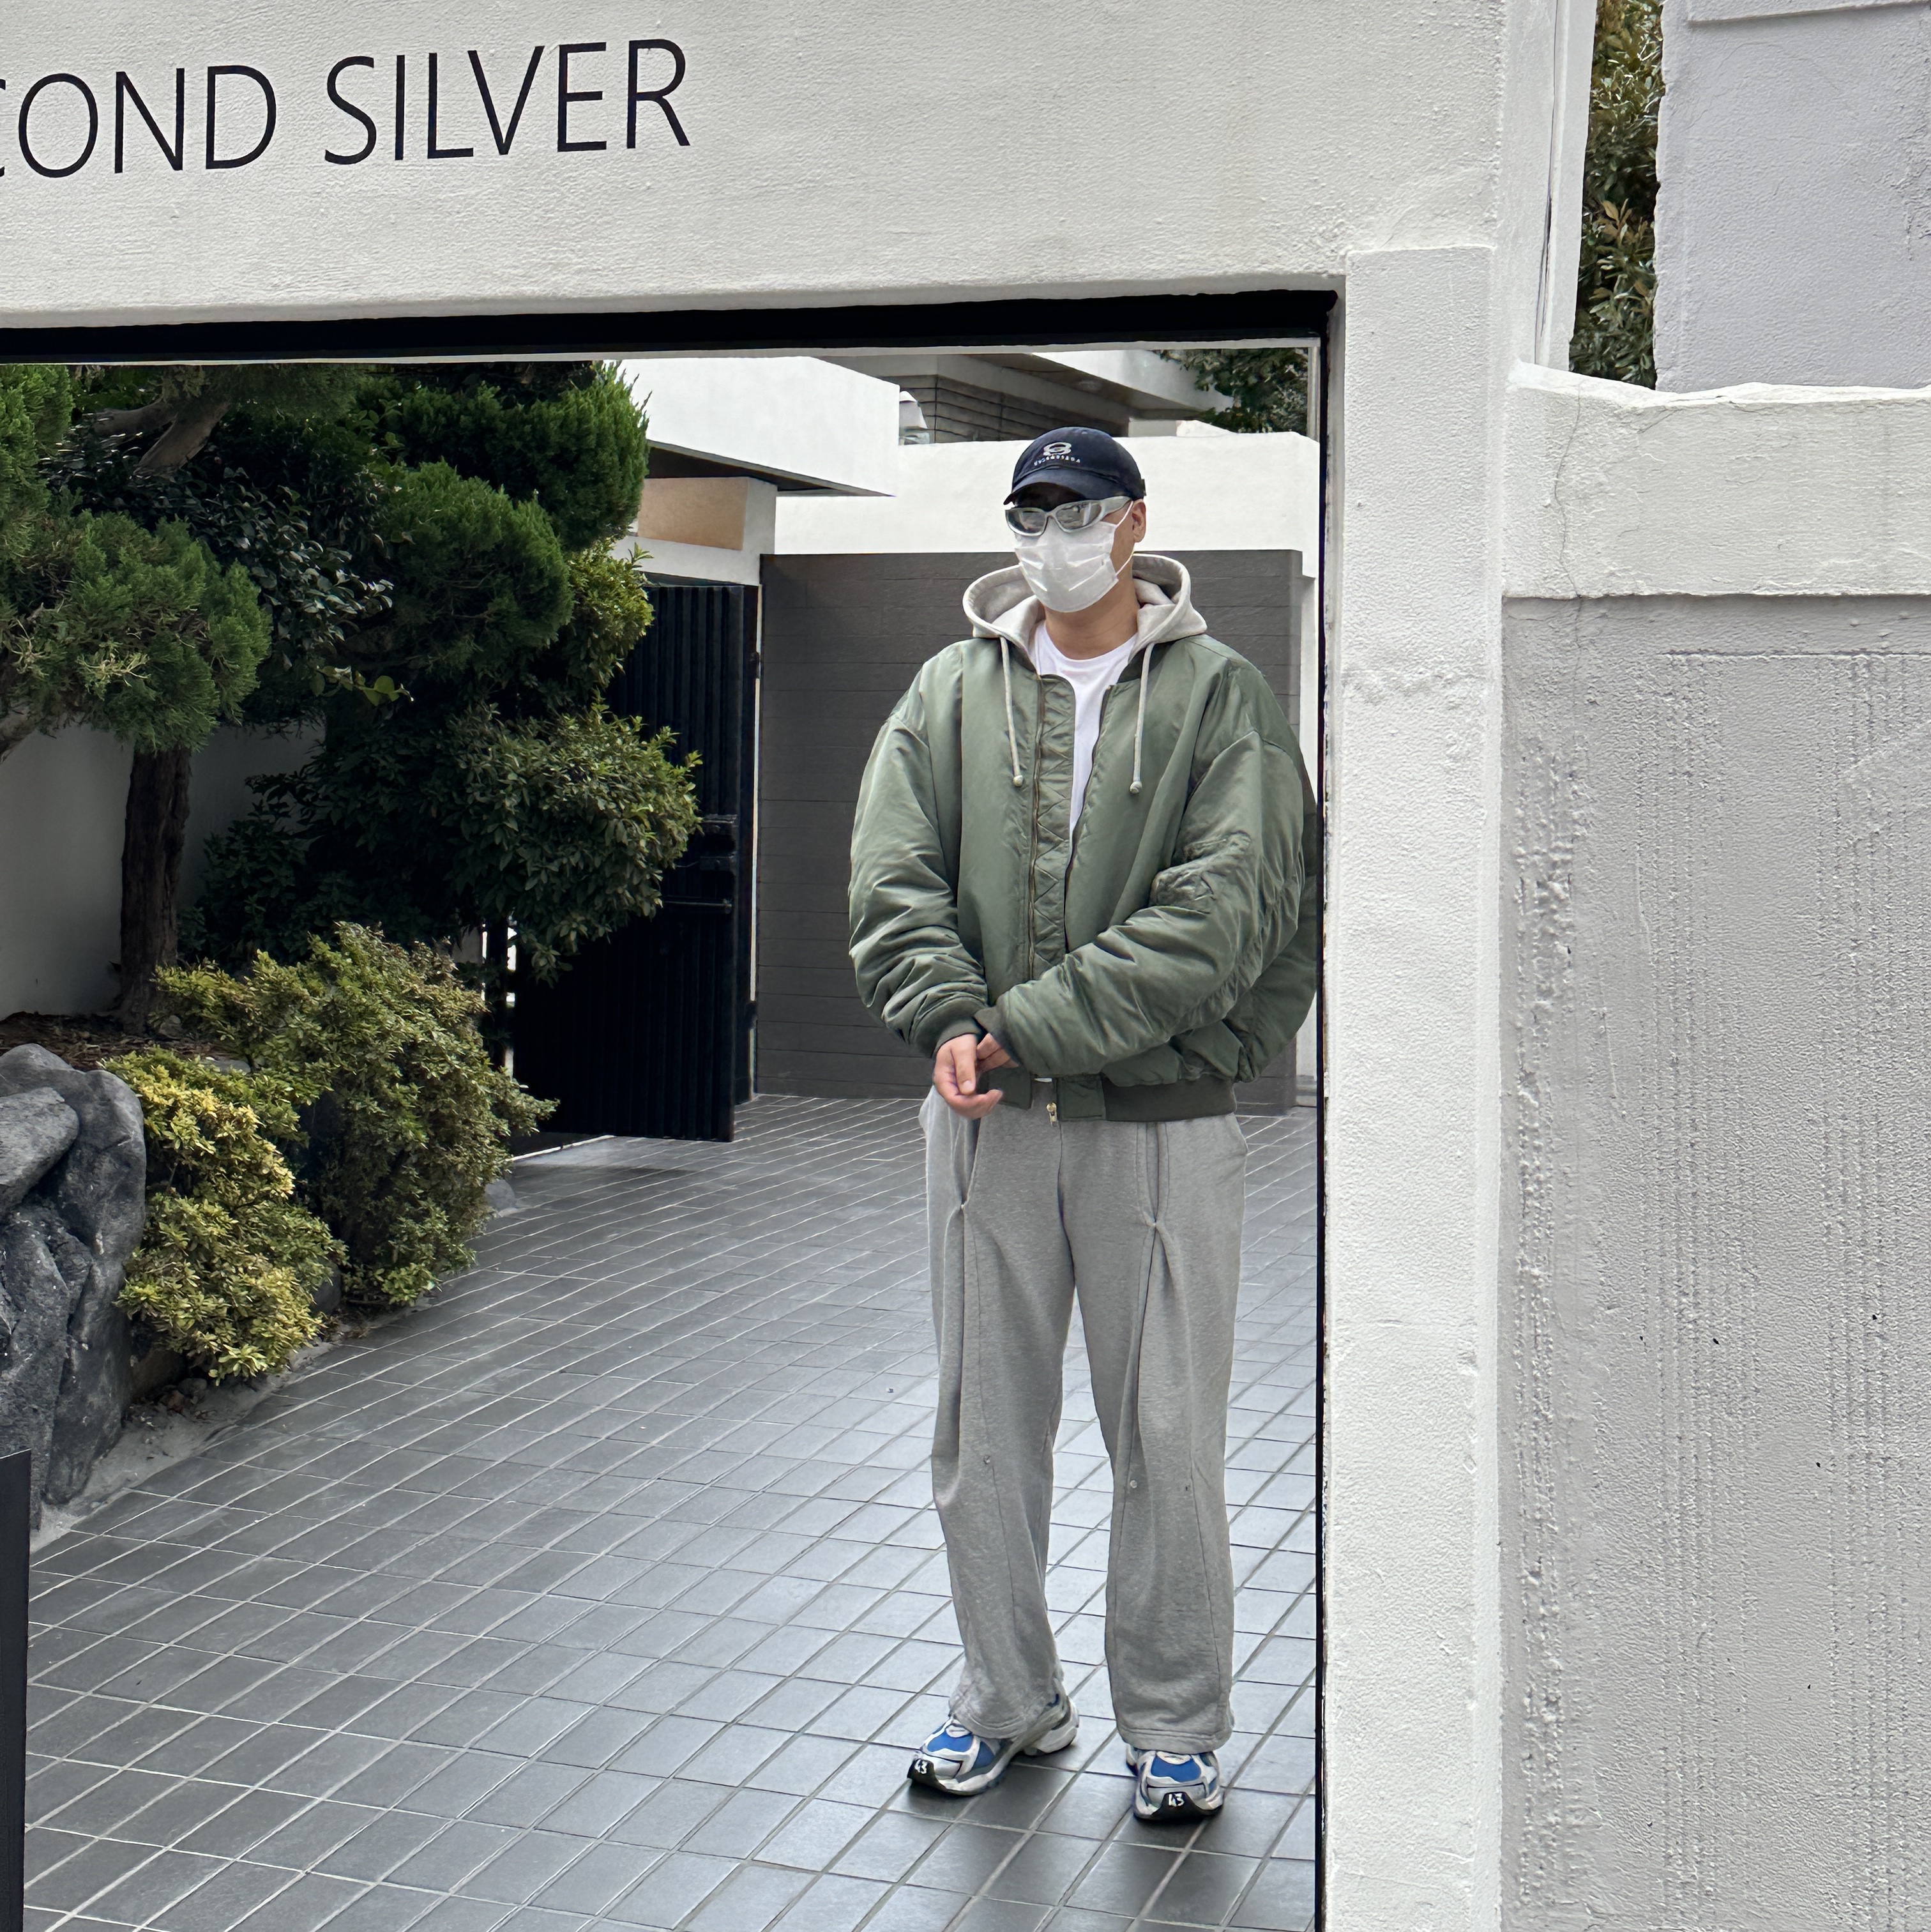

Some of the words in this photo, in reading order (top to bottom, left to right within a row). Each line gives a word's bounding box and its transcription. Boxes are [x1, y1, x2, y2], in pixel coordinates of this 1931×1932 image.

[0, 65, 276, 178] OND
[324, 38, 691, 165] SILVER
[914, 1759, 927, 1774] 43
